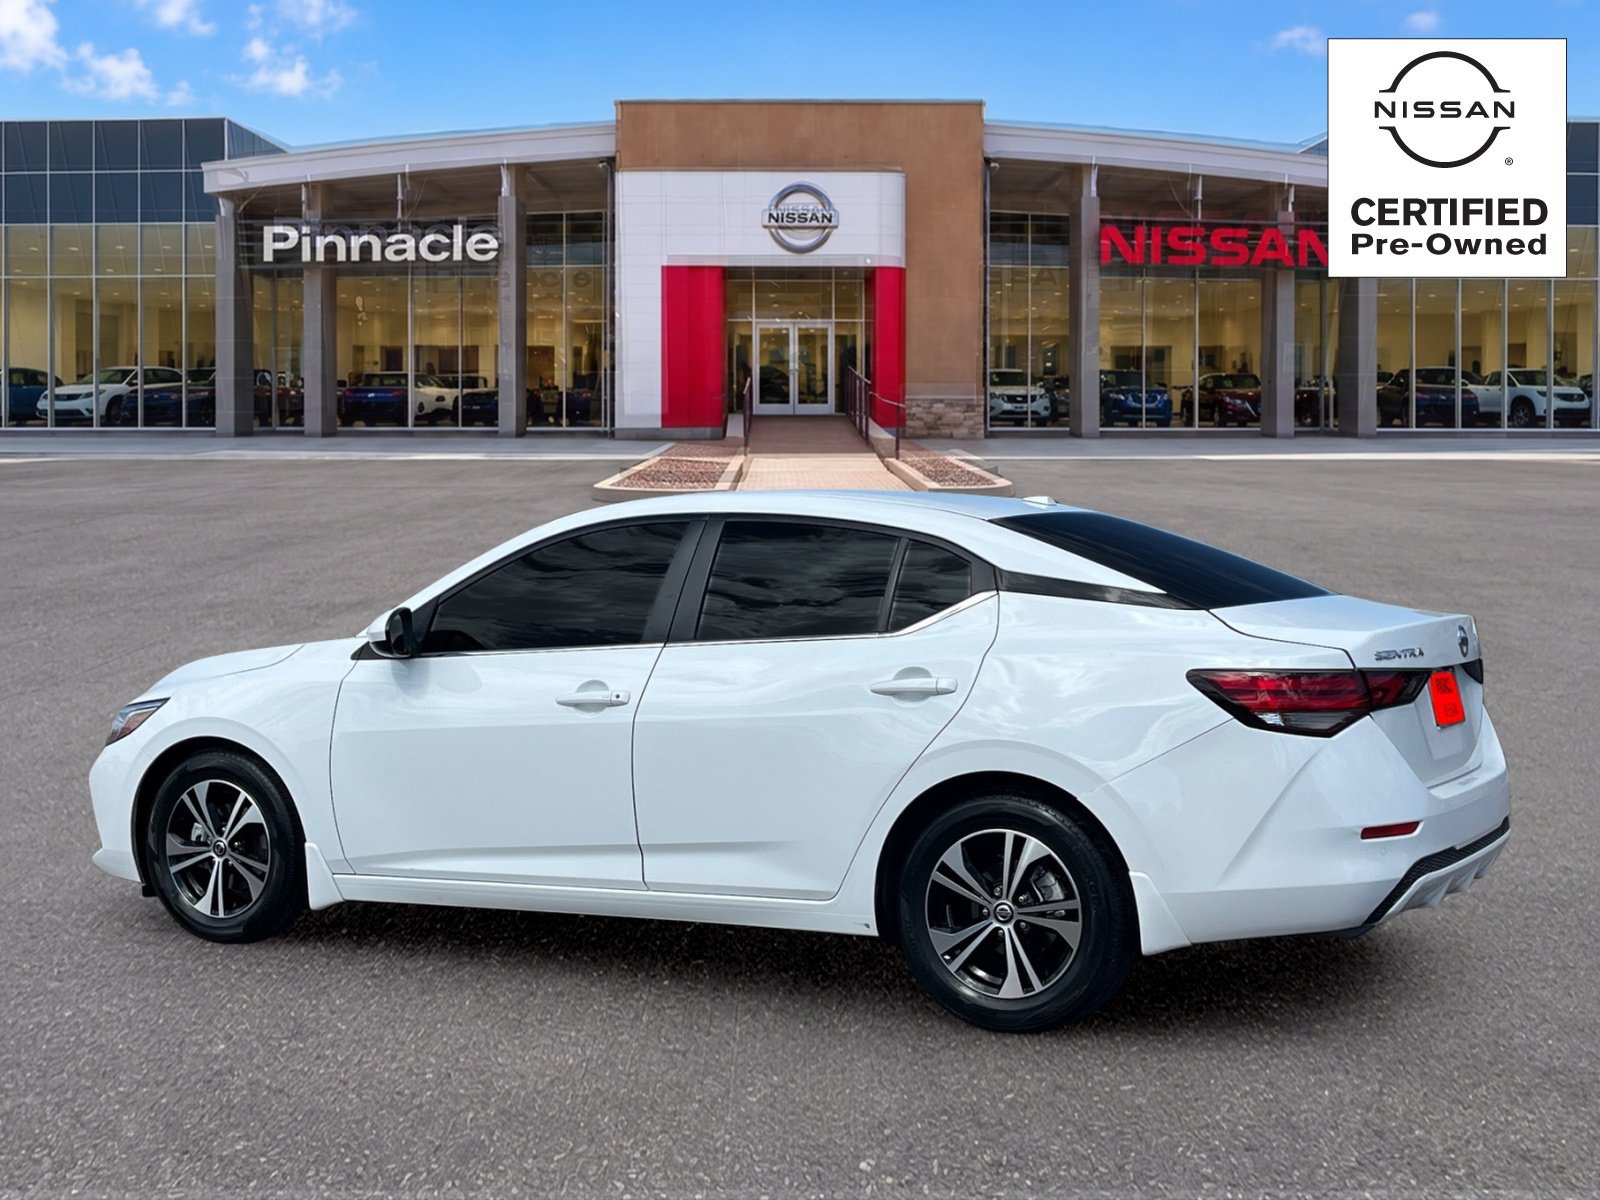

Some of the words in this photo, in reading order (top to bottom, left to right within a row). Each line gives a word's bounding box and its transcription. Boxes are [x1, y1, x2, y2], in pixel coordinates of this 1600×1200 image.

[767, 212, 833, 224] NISSAN
[262, 224, 499, 262] Pinnacle
[1100, 225, 1328, 267] NISSAN
[1374, 648, 1424, 661] SENTRA
